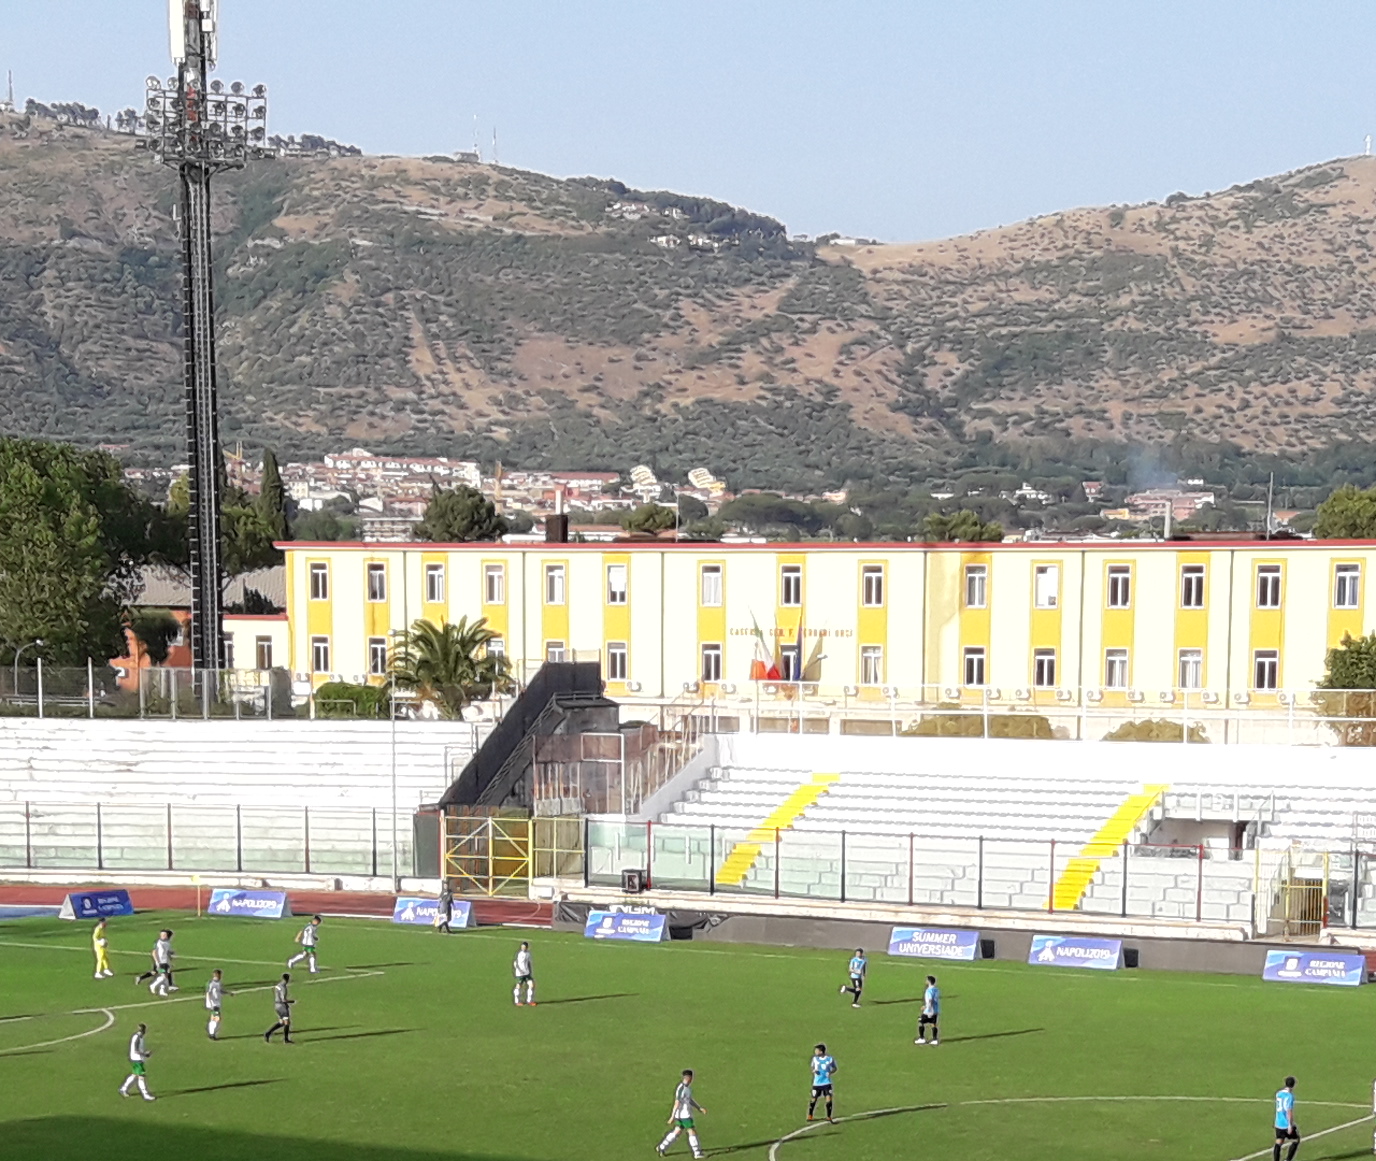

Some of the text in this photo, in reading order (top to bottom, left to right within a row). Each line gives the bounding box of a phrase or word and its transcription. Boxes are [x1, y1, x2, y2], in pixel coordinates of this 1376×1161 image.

[912, 932, 957, 945] SUMMER
[899, 943, 964, 957] UNIVERSIADE
[1056, 947, 1112, 960] NAPOLI2019
